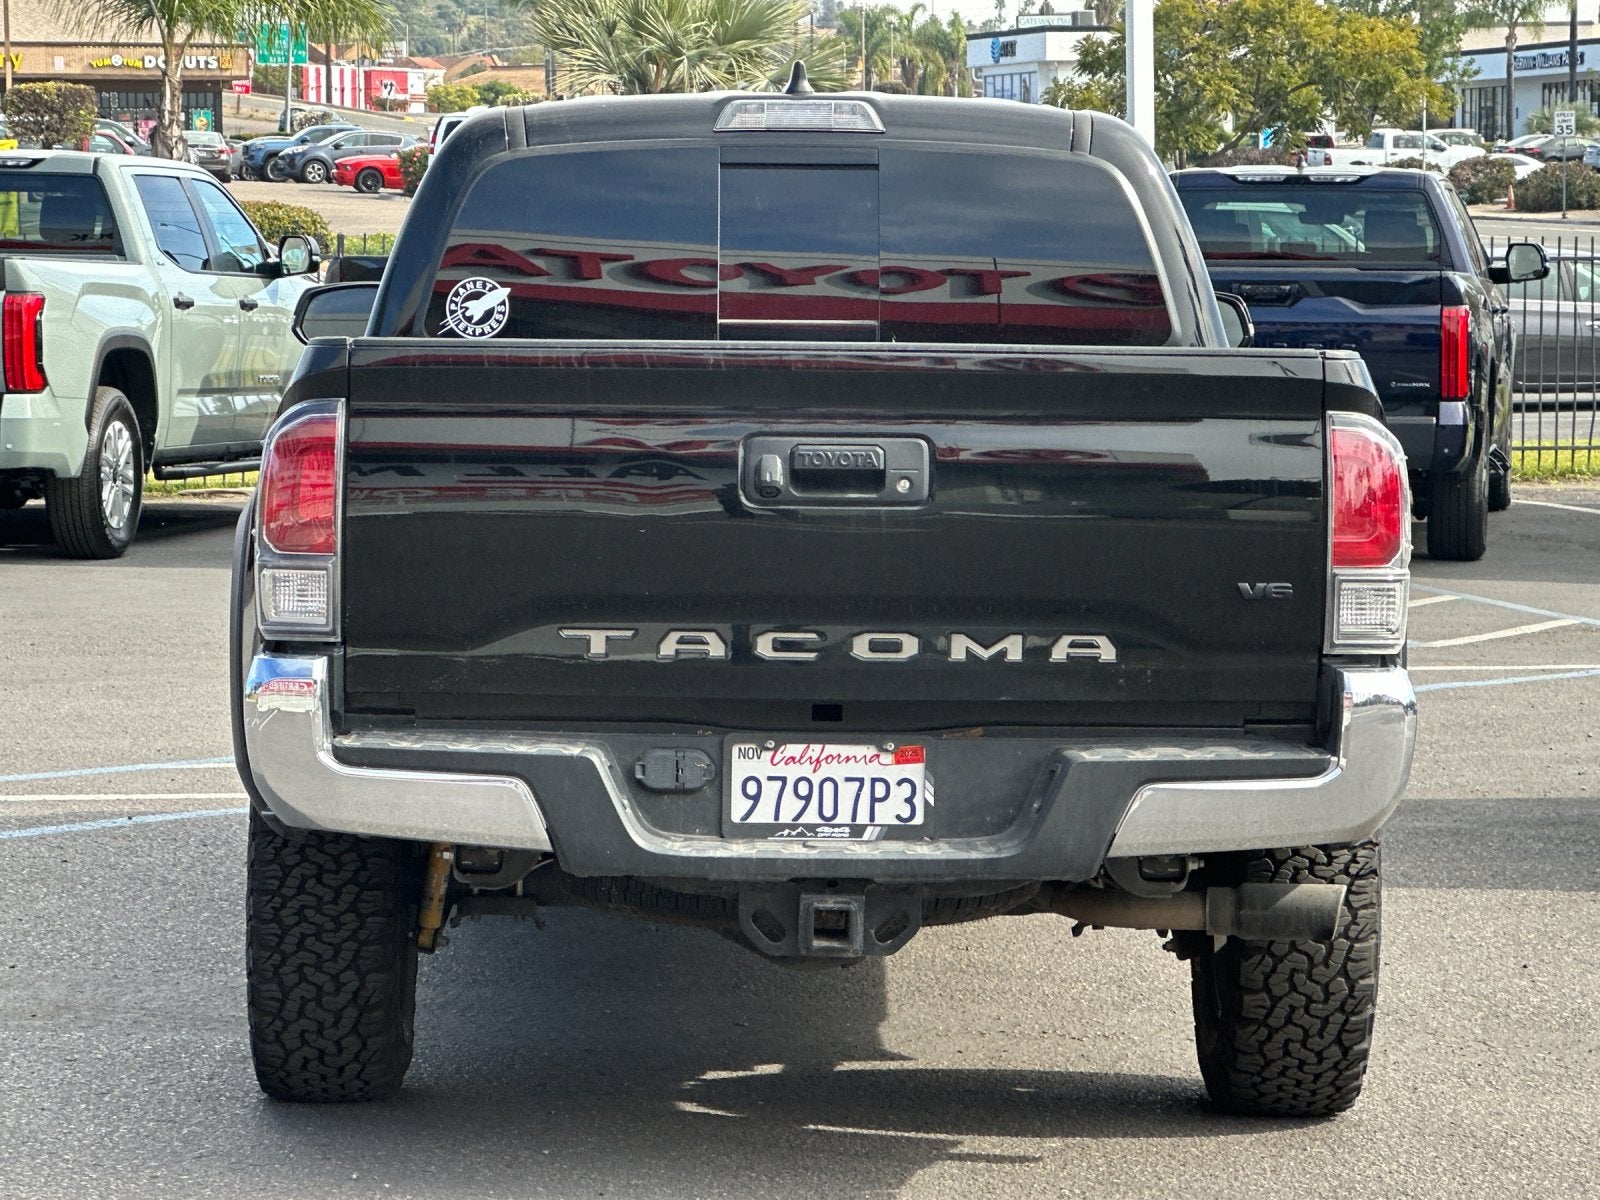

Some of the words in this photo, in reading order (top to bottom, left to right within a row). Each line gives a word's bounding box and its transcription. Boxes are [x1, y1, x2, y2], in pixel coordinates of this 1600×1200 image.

[90, 59, 112, 69] YUM
[122, 58, 143, 69] YUM
[144, 55, 218, 69] DOUTS
[1557, 125, 1574, 135] 35
[450, 281, 493, 310] PLANET
[458, 305, 505, 336] EXPRESS
[800, 451, 879, 467] TOYOTA
[1237, 582, 1294, 600] V6
[558, 627, 1118, 663] TACOMA
[738, 747, 762, 760] NOV
[770, 743, 893, 774] California
[739, 775, 917, 823] 97907P3
